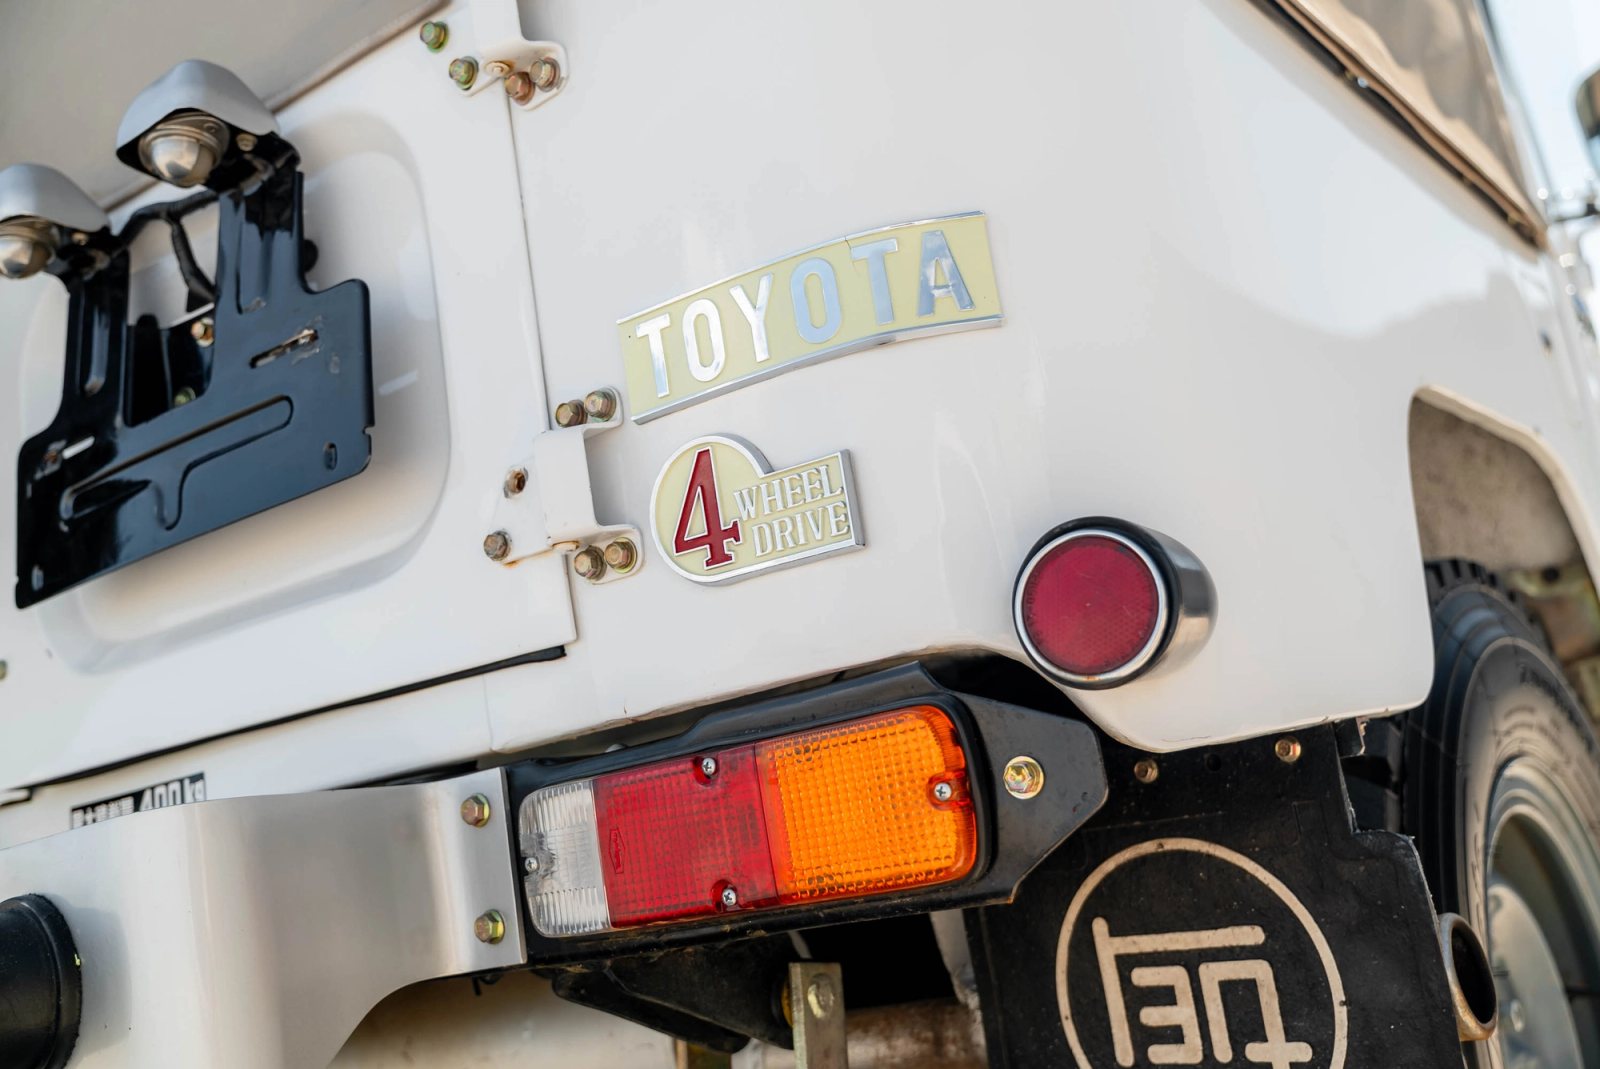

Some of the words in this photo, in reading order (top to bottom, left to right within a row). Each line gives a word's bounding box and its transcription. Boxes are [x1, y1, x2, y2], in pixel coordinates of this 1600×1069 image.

[635, 230, 975, 398] TOYOTA
[674, 446, 741, 570] 4
[733, 465, 843, 520] WHEEL
[751, 500, 851, 557] DRIVE
